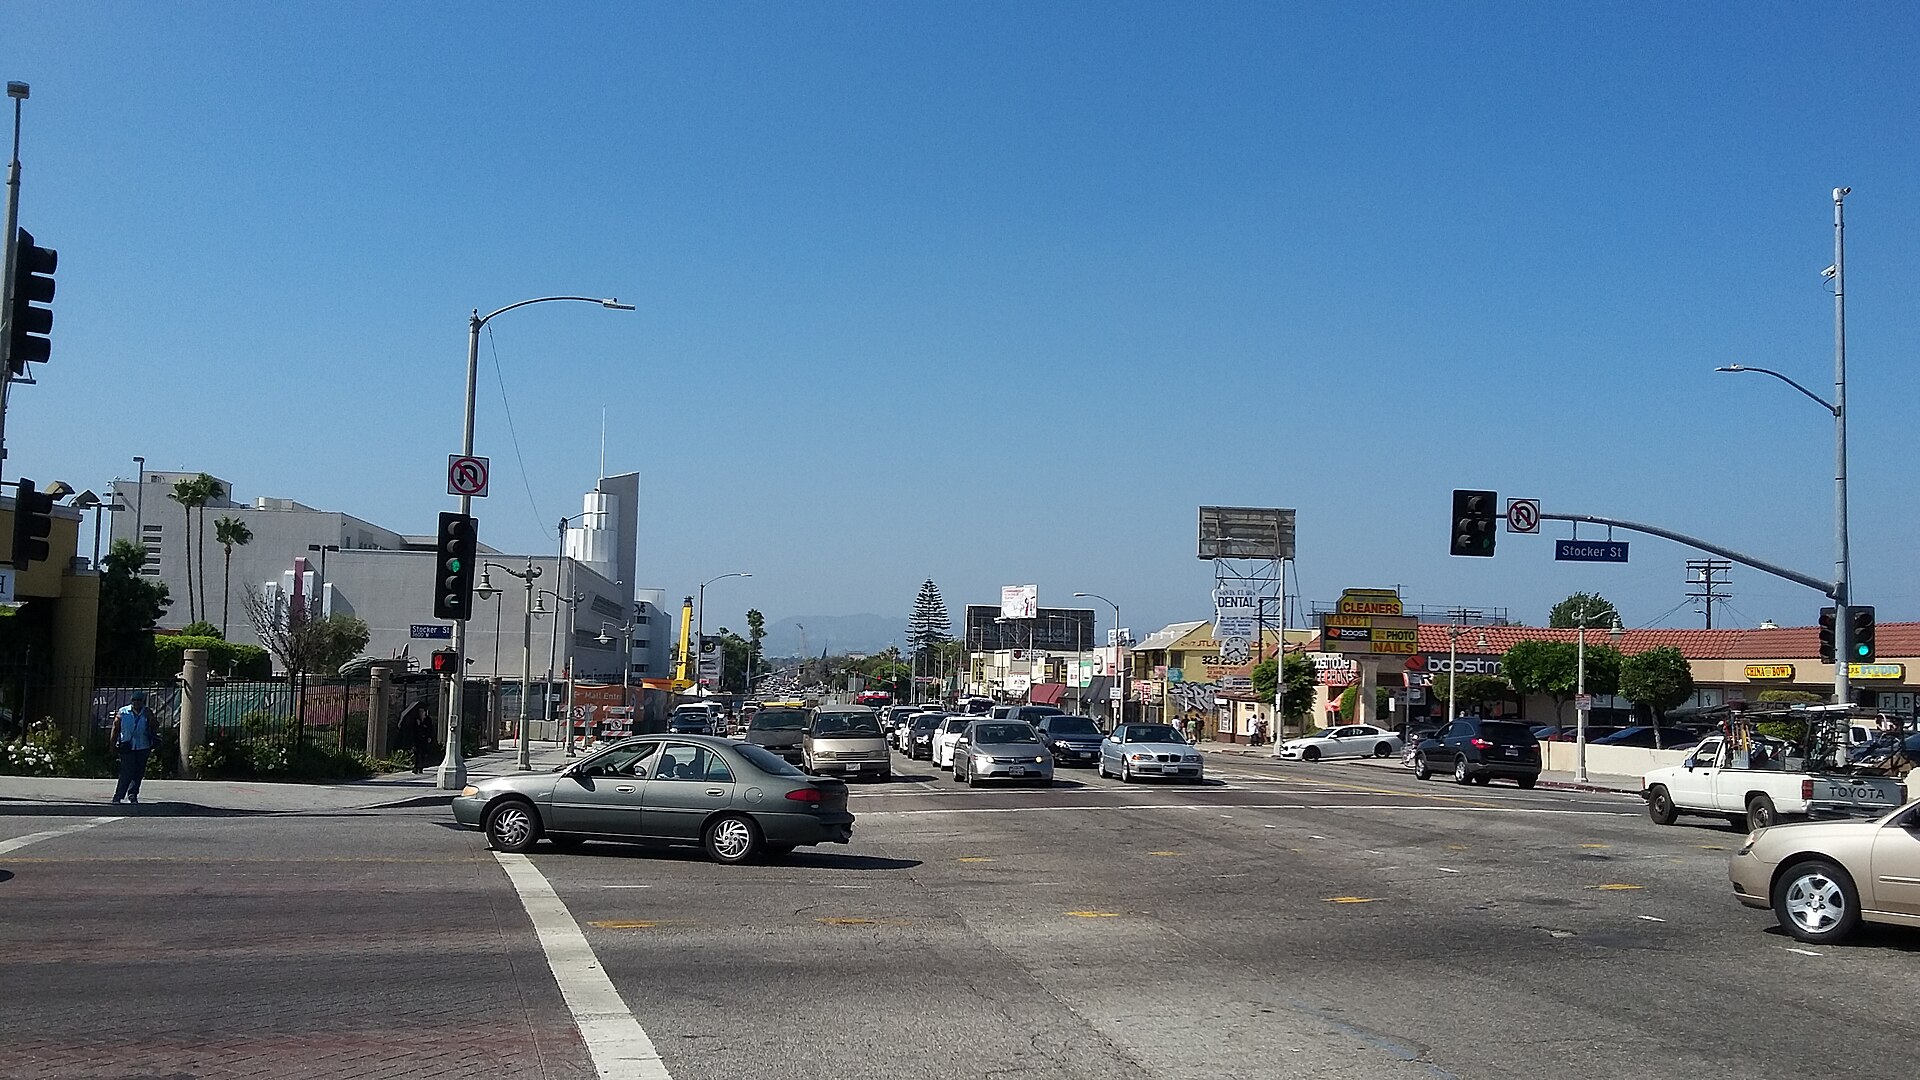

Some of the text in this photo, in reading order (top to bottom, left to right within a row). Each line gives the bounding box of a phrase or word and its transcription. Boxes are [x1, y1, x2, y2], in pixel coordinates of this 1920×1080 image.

[1562, 545, 1622, 558] Stocker St
[1217, 596, 1256, 608] DENTAL
[1343, 602, 1400, 614] CLEANERS
[1326, 615, 1368, 626] MARKET
[412, 625, 438, 633] Stocker
[1341, 628, 1368, 637] boost
[1386, 630, 1415, 641] PHOTO
[1373, 642, 1414, 653] NAILS
[1201, 655, 1219, 665] 323
[1427, 655, 1503, 674] boostm
[1746, 666, 1790, 677] CHINA BOWL
[1860, 665, 1900, 675] STUDIO
[584, 690, 602, 701] Mall
[1828, 786, 1886, 800] TOYOTA
